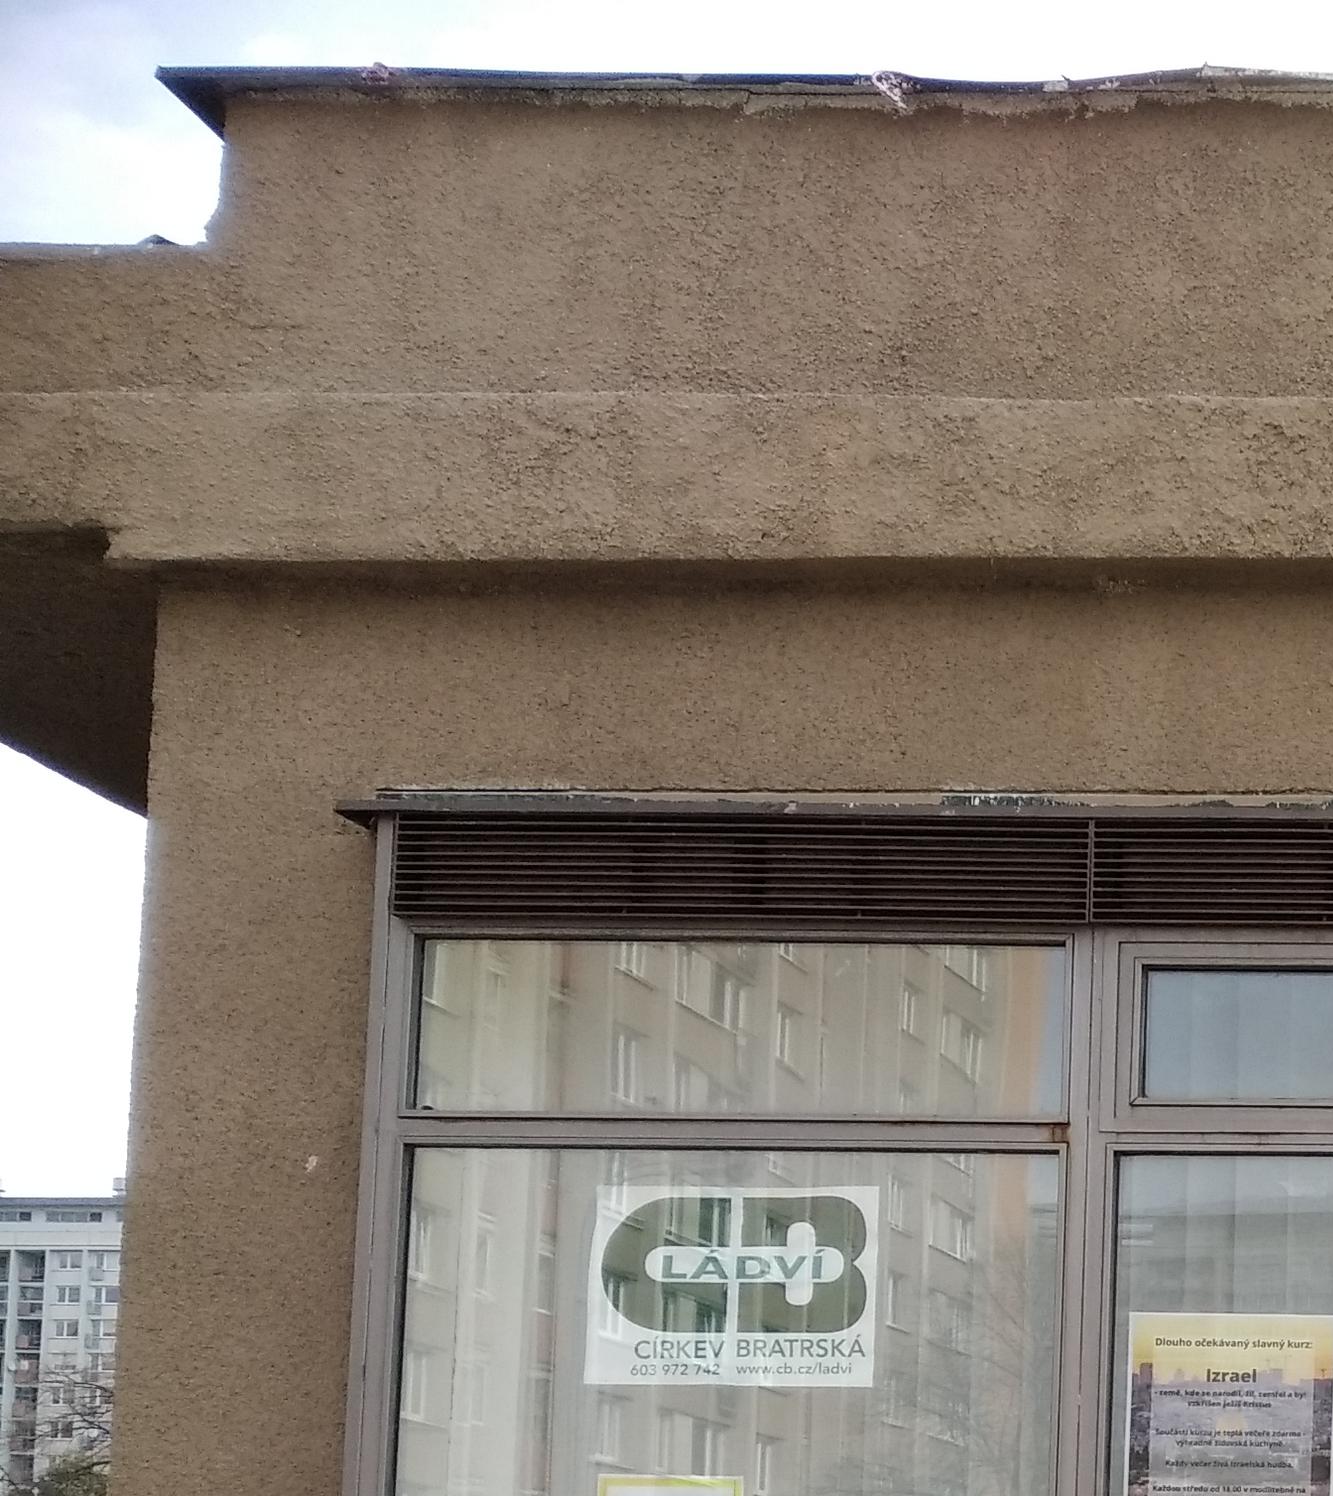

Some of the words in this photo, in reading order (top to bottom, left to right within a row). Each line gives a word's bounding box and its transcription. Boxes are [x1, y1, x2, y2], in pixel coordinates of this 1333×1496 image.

[661, 1249, 824, 1279] LÁDVÍ
[634, 1336, 725, 1360] CÍRKEV
[736, 1334, 866, 1358] BRATRSKÁ
[1155, 1337, 1193, 1348] Dlouho
[1194, 1337, 1250, 1350] očekávaný
[1252, 1338, 1286, 1350] slavný
[1287, 1339, 1313, 1349] kurz:
[630, 1363, 657, 1376] 603
[662, 1363, 688, 1376] 972
[693, 1363, 720, 1375] 742
[736, 1362, 852, 1375] www.cb.cz/ladvi
[1206, 1368, 1257, 1383] Izrael
[1184, 1389, 1200, 1397] kde
[1213, 1429, 1221, 1438] je
[1223, 1429, 1243, 1438] teplá
